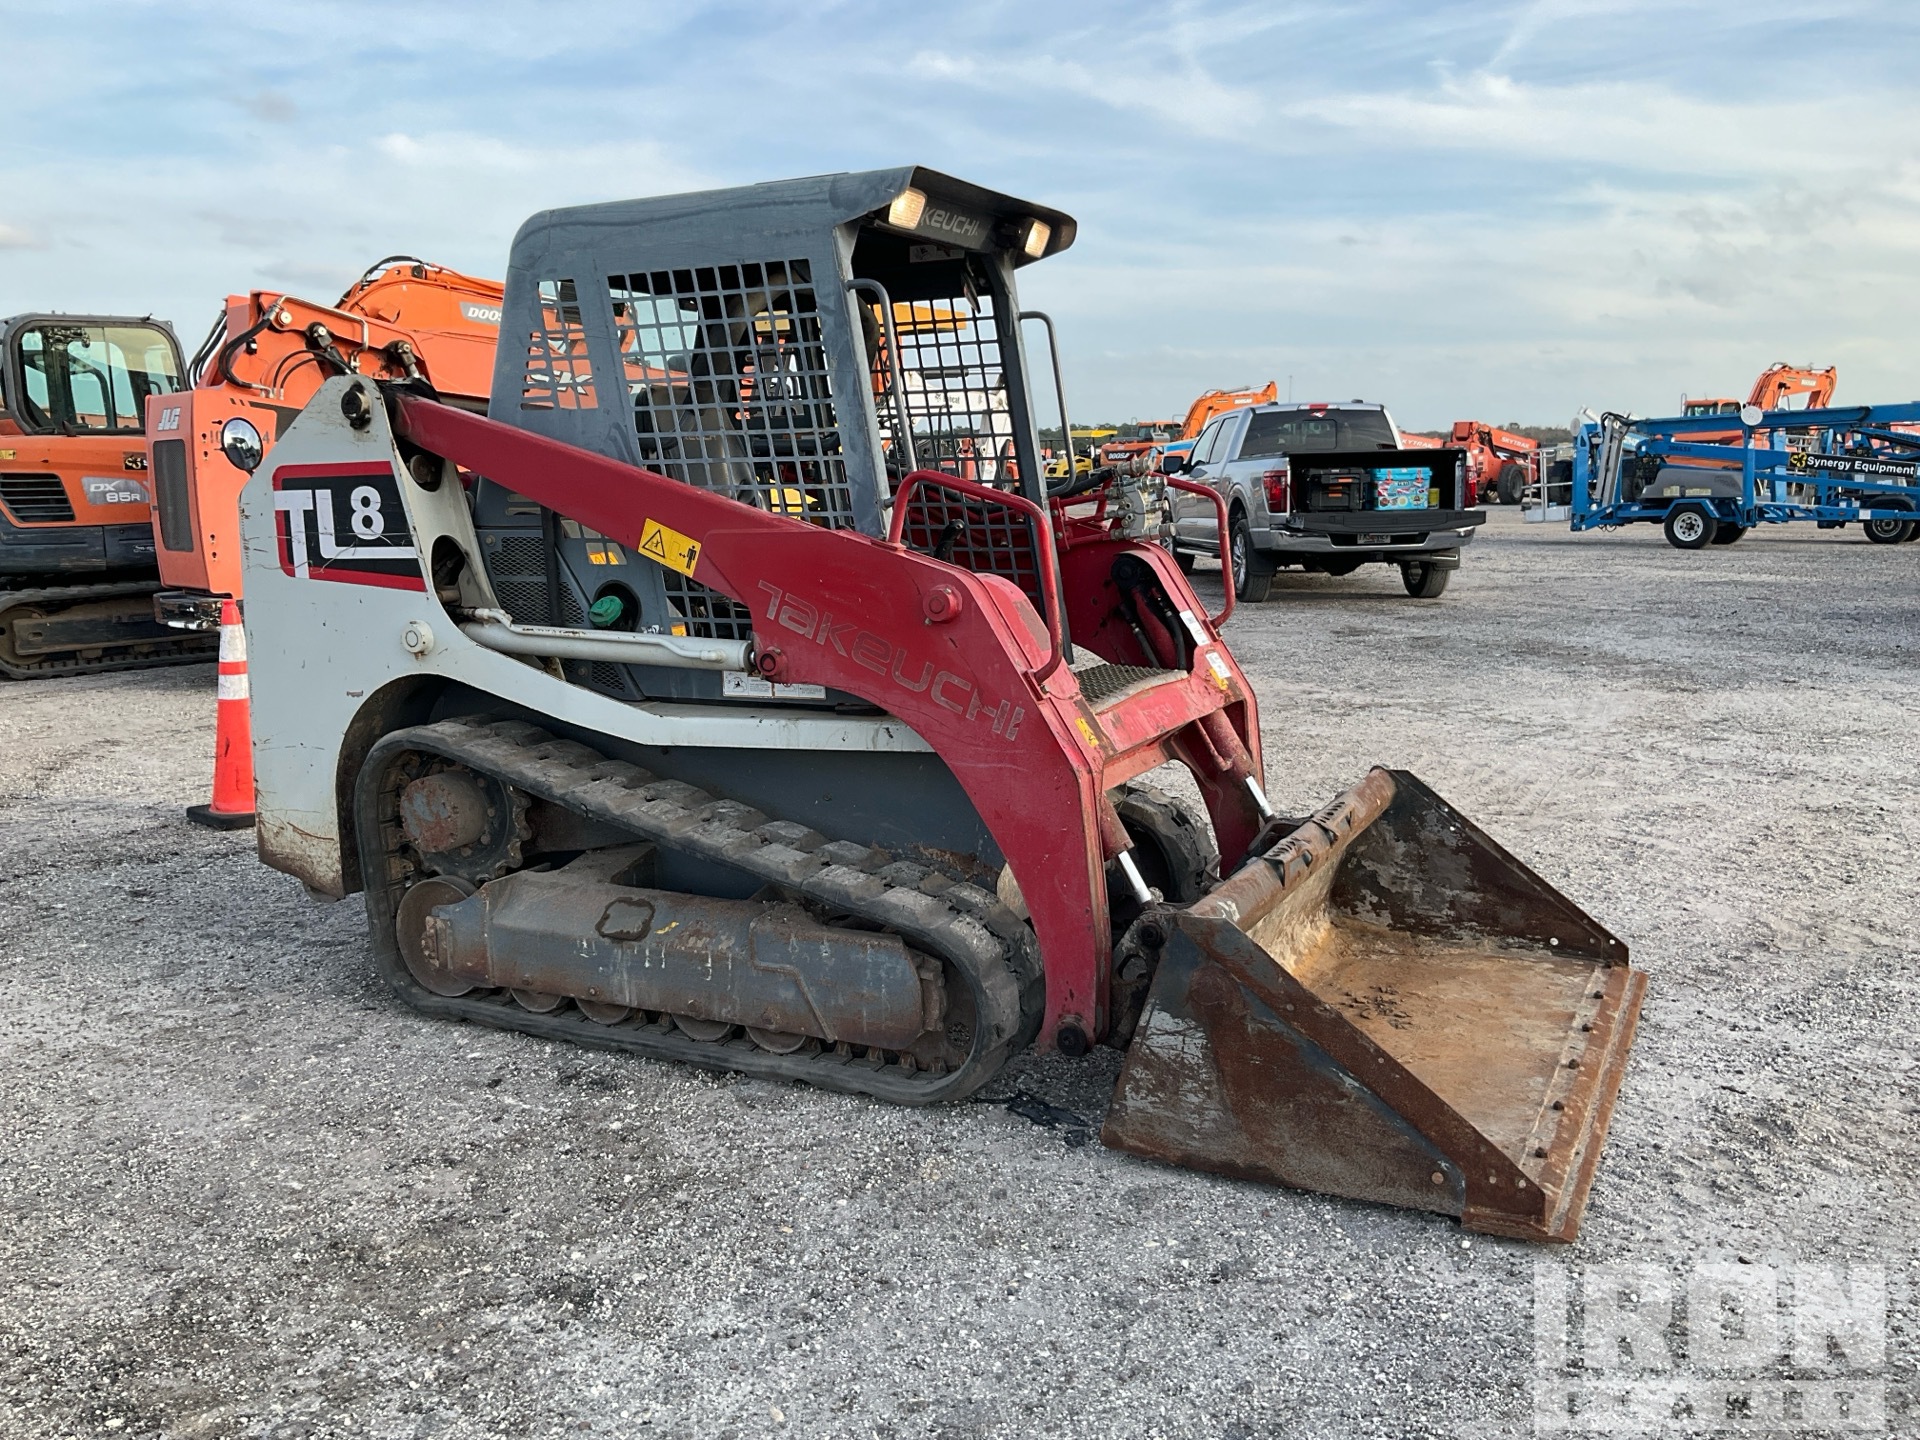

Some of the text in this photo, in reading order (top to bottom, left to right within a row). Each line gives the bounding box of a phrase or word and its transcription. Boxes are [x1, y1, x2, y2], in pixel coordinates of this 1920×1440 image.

[157, 407, 181, 431] JLG
[1501, 436, 1530, 450] SKYTRAK
[1807, 456, 1915, 475] Synergy Equipment
[89, 480, 121, 493] DX
[105, 491, 141, 503] 85R
[273, 485, 420, 579] TL8
